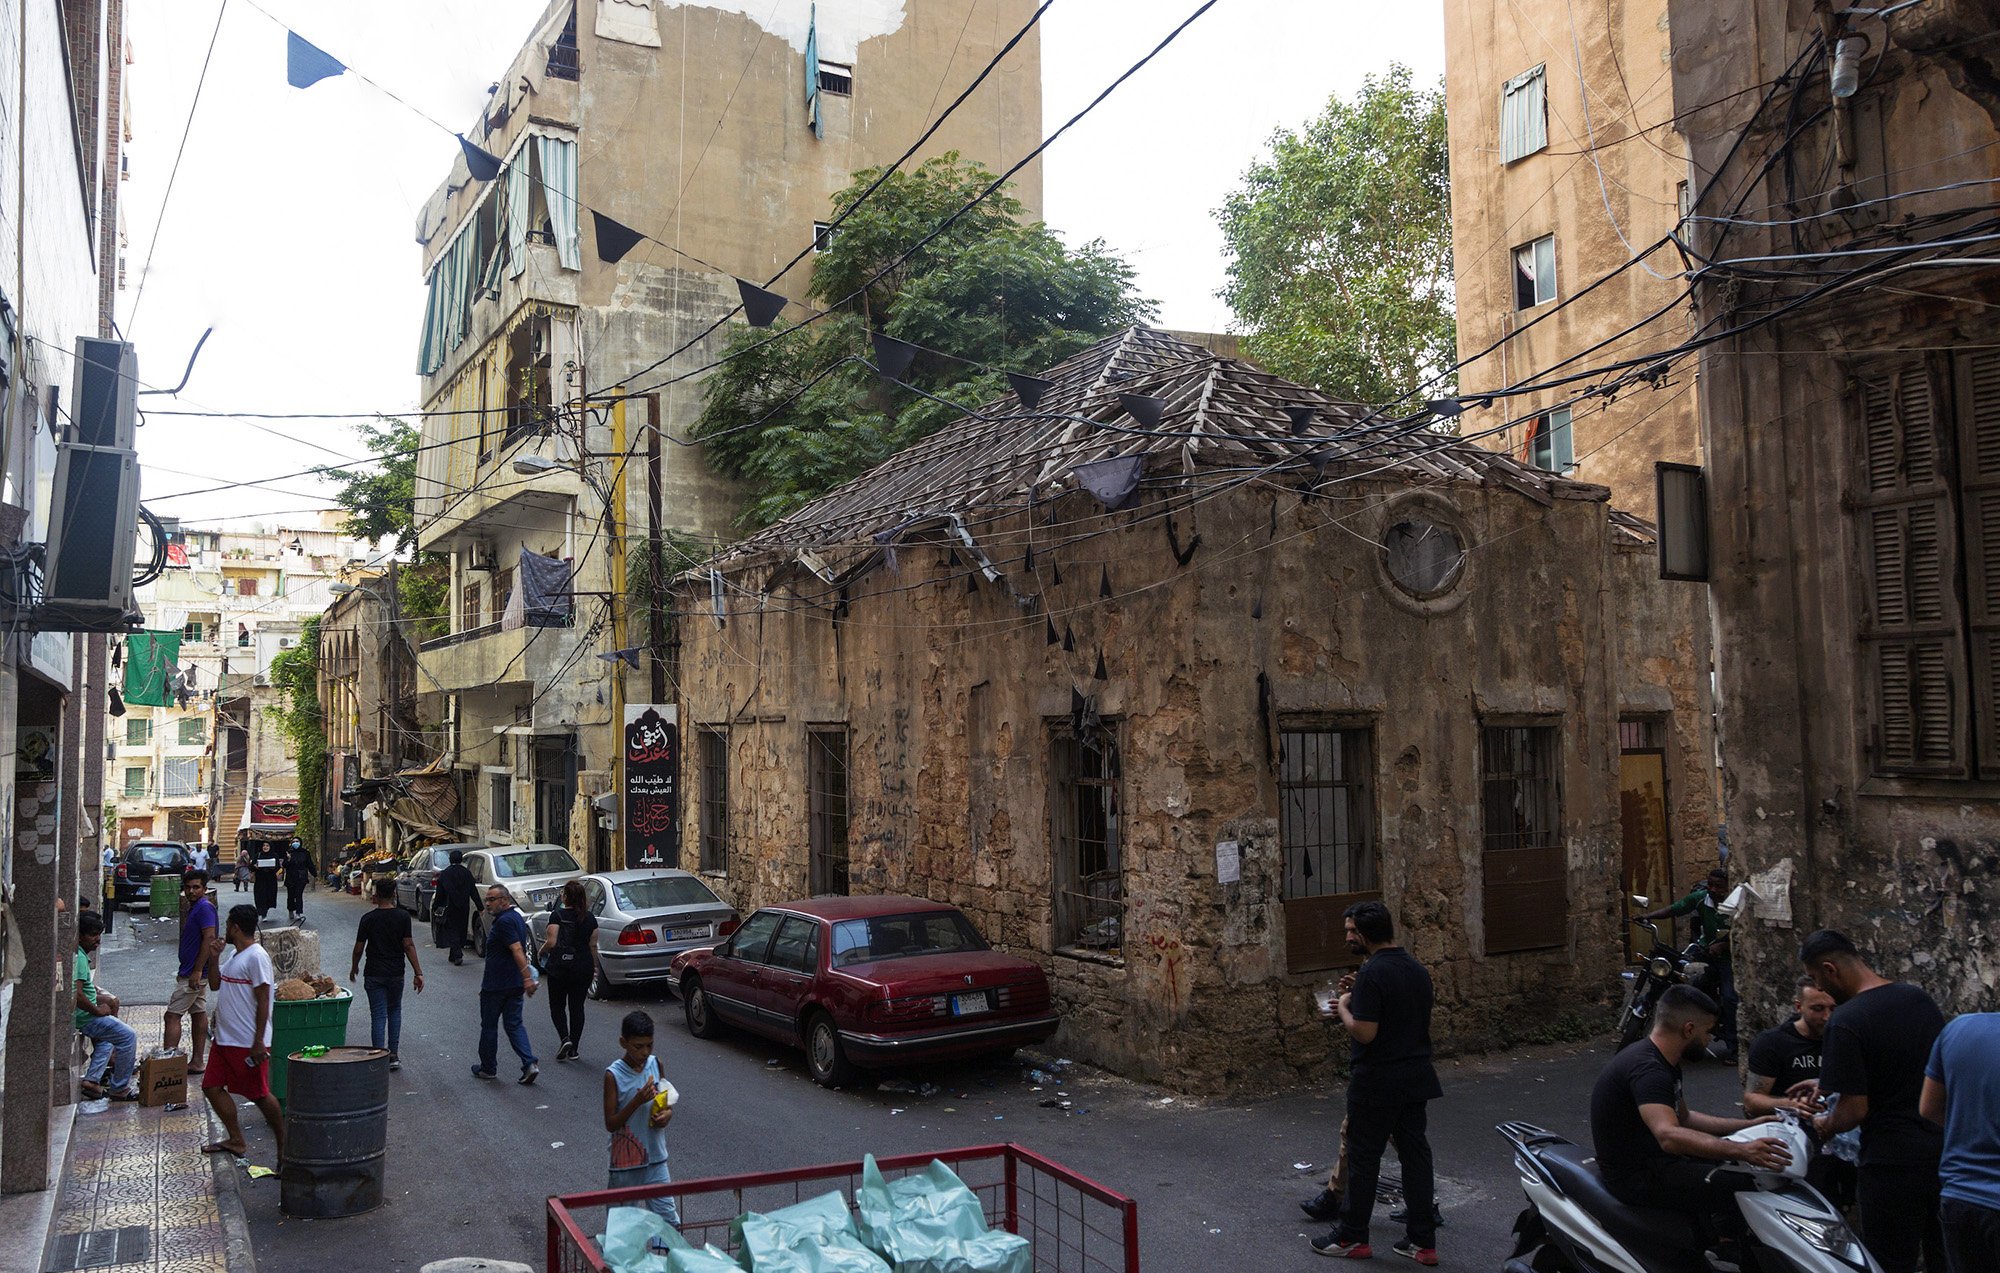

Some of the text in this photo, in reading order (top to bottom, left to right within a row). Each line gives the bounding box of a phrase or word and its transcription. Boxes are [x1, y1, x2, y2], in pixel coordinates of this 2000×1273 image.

[630, 775, 644, 784] الله
[665, 775, 672, 784] لا
[630, 786, 672, 795] العيش بعدك
[1792, 1055, 1816, 1068] AIR
